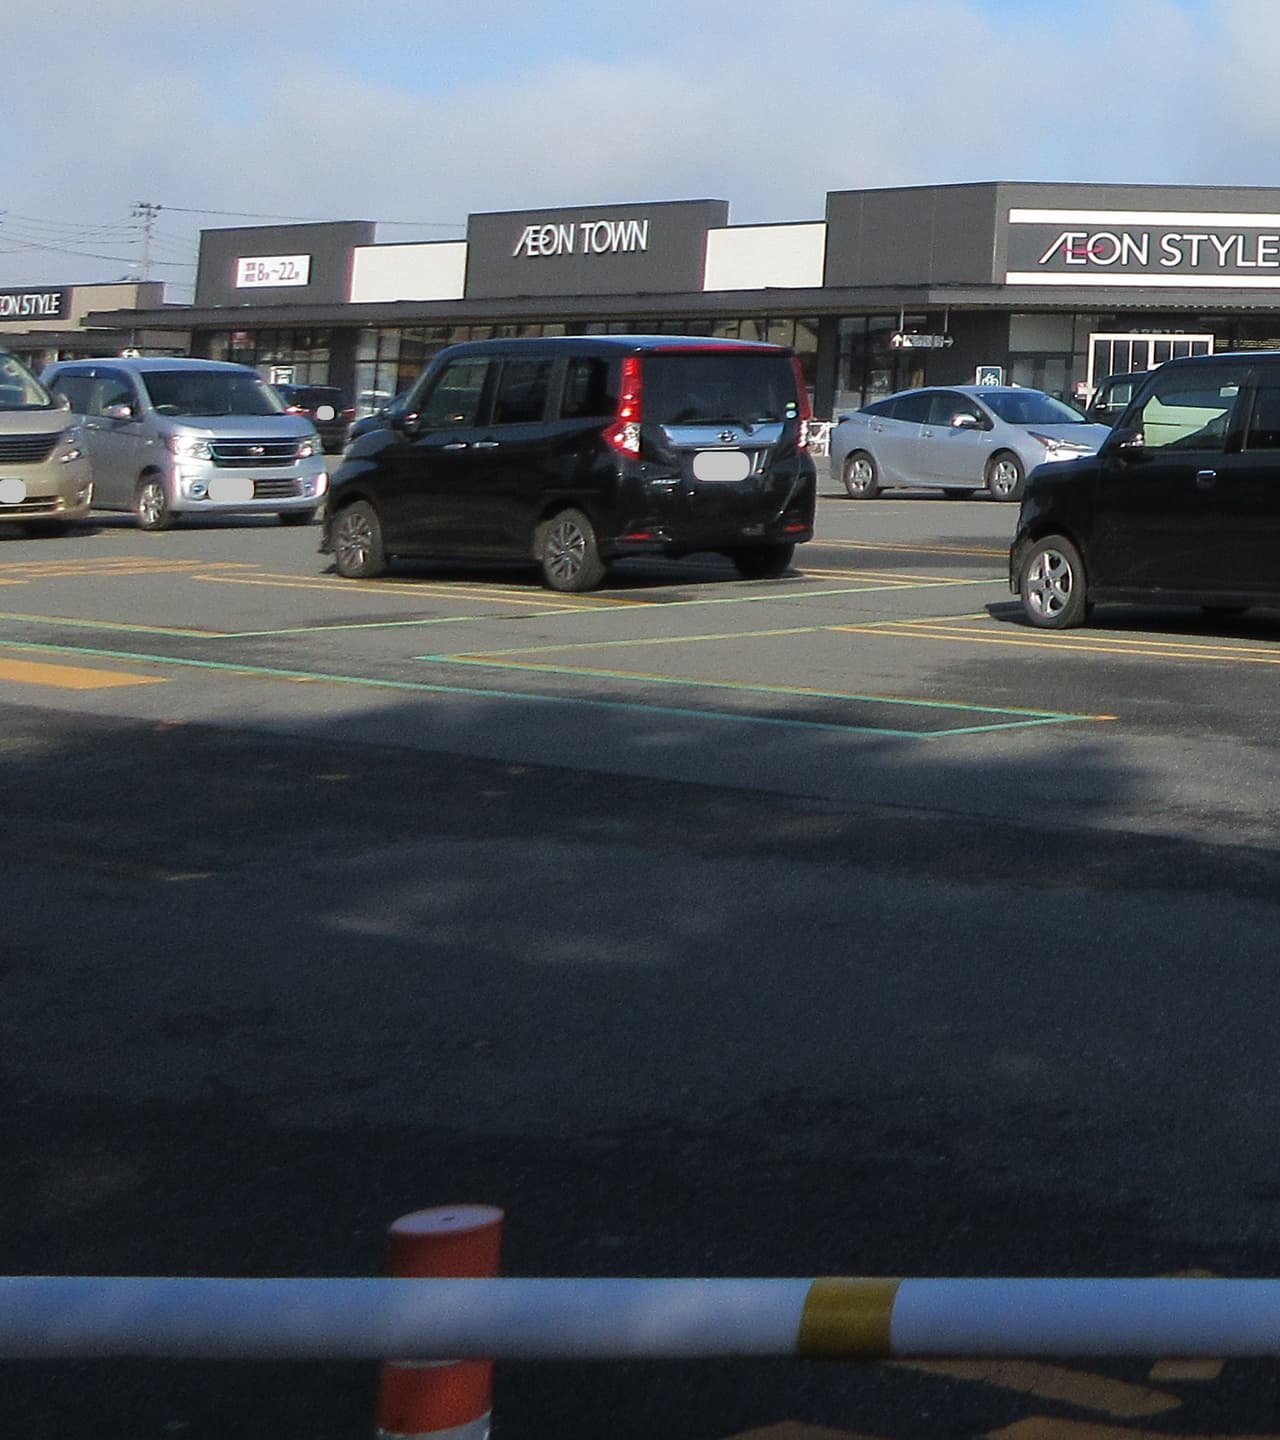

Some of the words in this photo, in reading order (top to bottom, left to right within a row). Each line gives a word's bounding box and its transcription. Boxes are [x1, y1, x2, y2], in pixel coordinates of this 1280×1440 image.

[580, 219, 649, 254] TOWN
[1159, 233, 1280, 268] STYLE
[21, 293, 61, 315] STYLE
